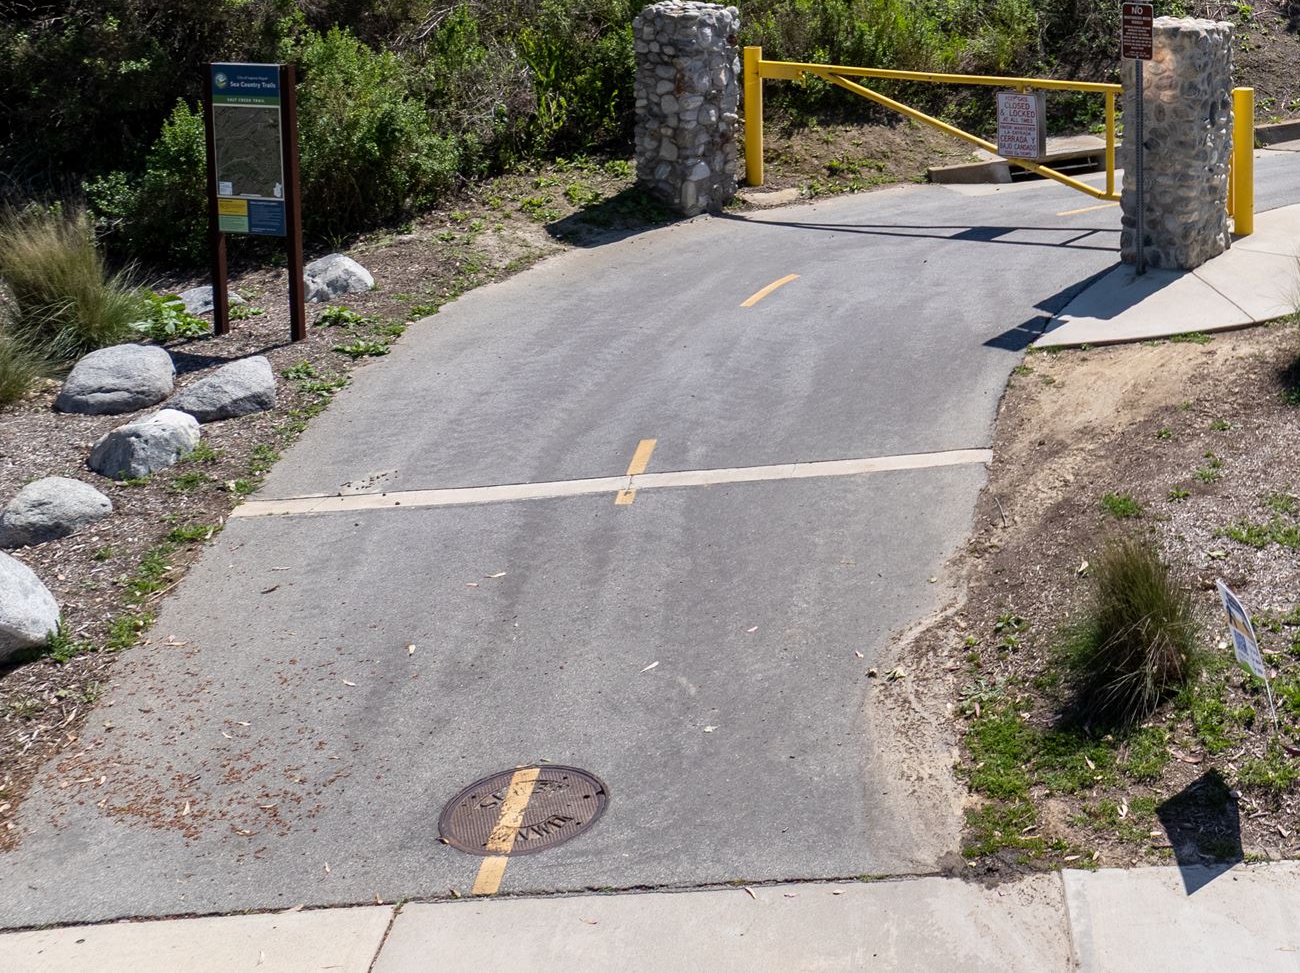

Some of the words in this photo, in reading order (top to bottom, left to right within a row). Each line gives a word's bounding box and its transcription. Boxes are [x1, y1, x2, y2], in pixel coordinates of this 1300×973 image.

[1131, 6, 1143, 15] NO
[1004, 102, 1030, 110] CLOSED
[1010, 110, 1035, 118] LOCKED
[1000, 134, 1028, 144] CERRADA
[1014, 143, 1036, 152] CANDADO
